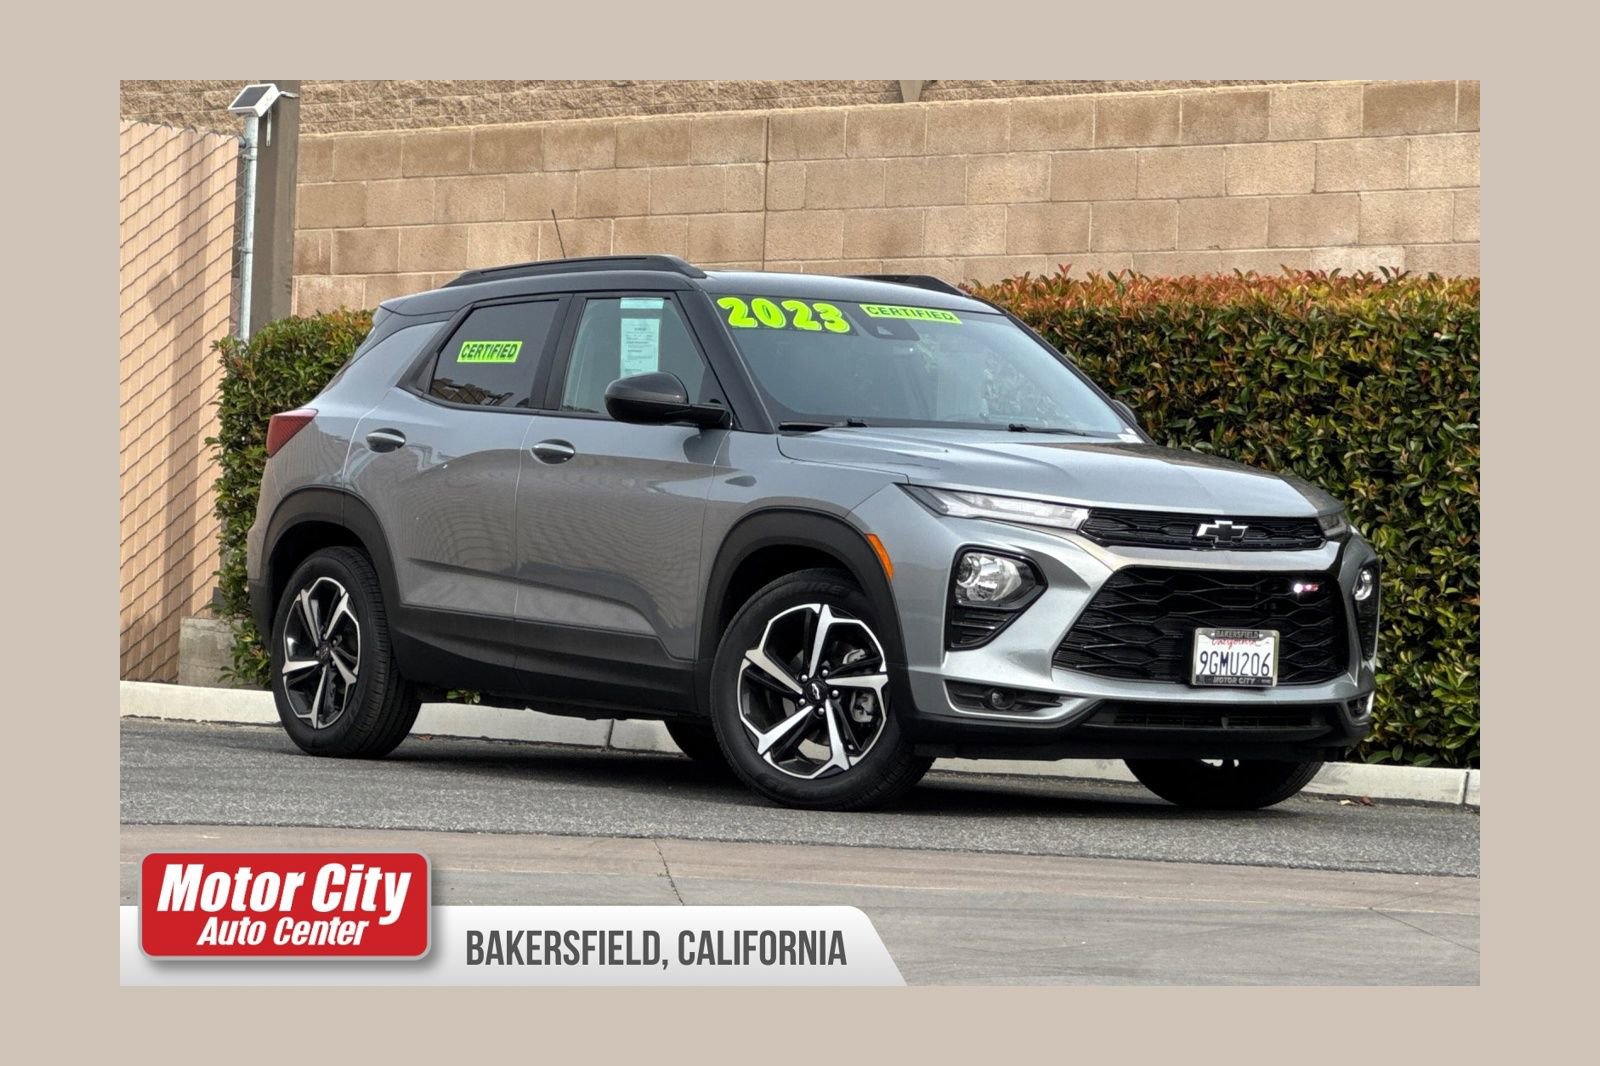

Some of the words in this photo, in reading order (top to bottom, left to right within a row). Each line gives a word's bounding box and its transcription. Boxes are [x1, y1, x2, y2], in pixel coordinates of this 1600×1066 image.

[717, 297, 850, 334] 2023
[866, 305, 954, 321] CERTIFIED
[460, 343, 518, 360] CERTIFIED
[1200, 650, 1271, 676] 9GMU206
